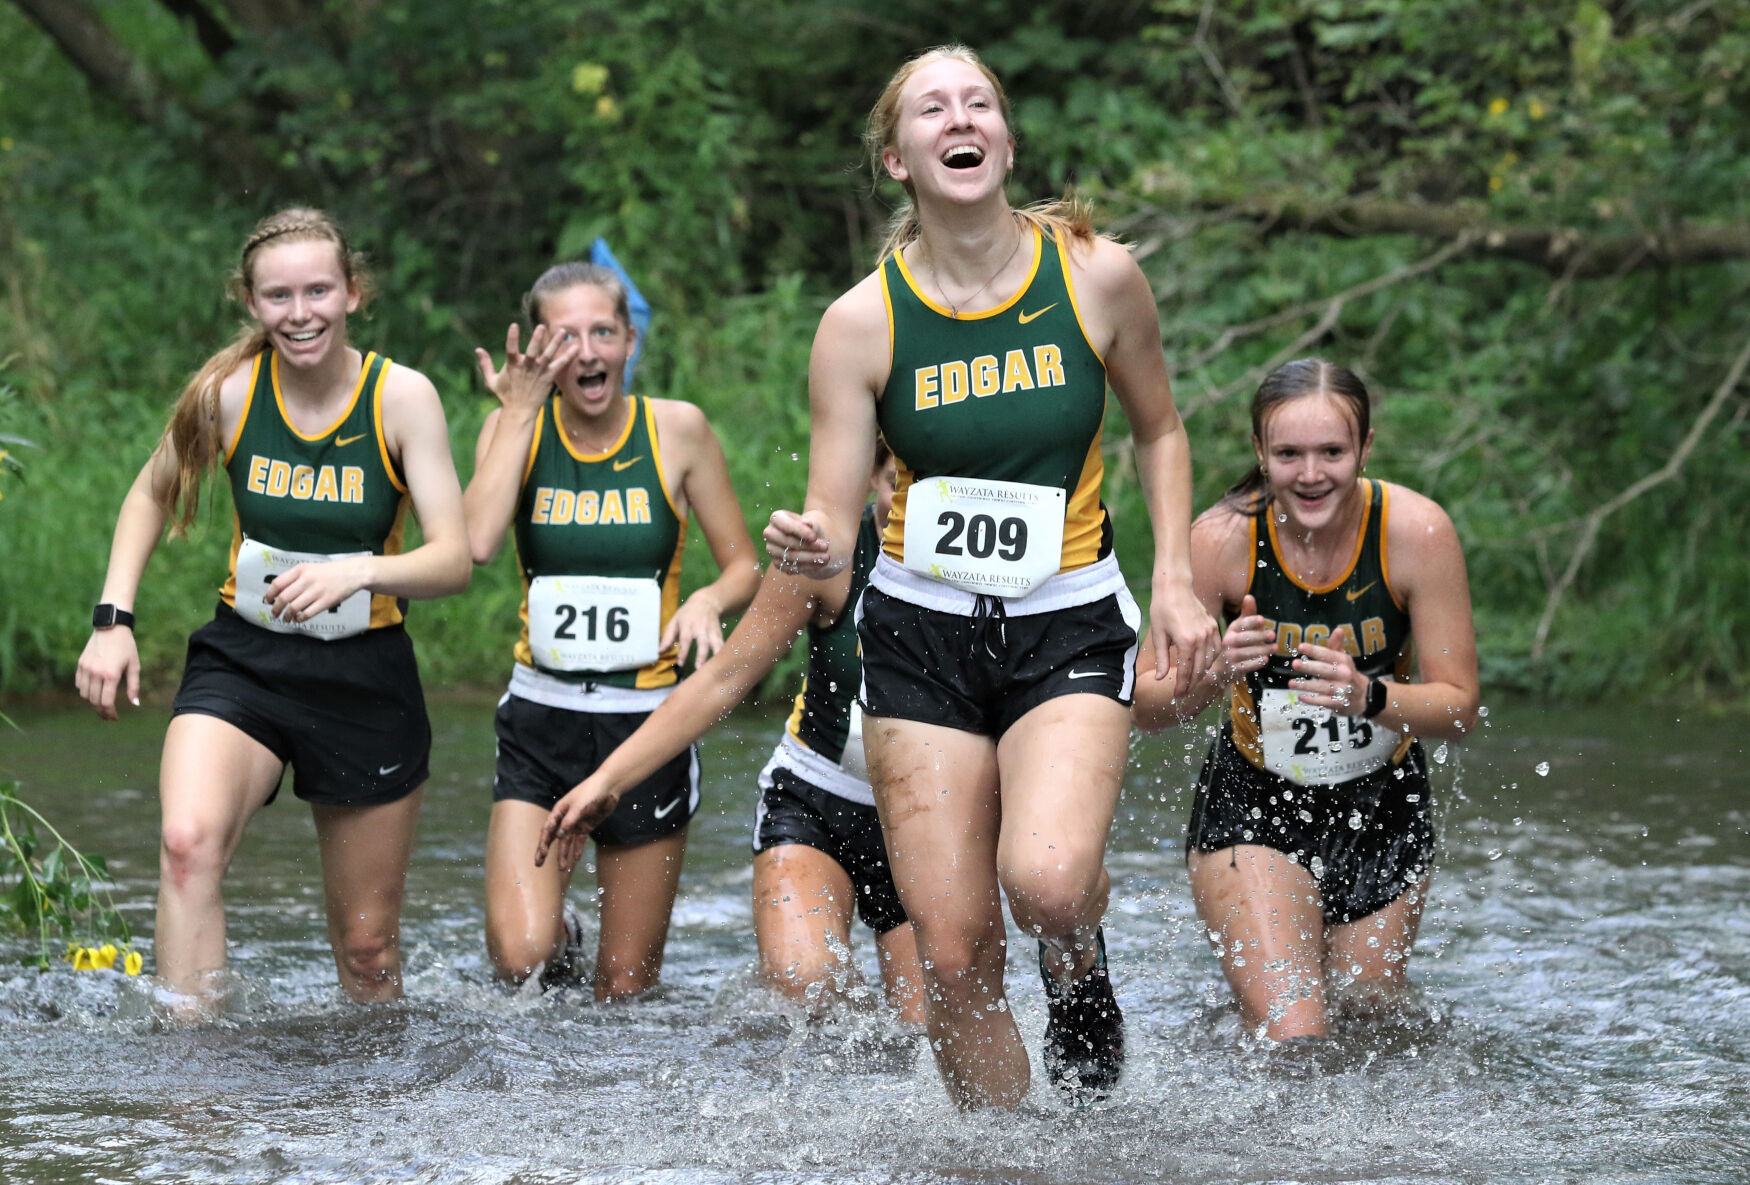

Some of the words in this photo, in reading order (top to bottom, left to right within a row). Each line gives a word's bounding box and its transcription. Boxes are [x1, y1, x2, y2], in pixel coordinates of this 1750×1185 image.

[915, 344, 1066, 411] EDGAR
[248, 455, 364, 503] EDGAR
[949, 485, 994, 498] WAYZATA
[997, 489, 1040, 502] RESULTS
[531, 487, 652, 525] EDGAR
[935, 511, 1028, 562] 209
[942, 569, 987, 582] WAYZATA
[989, 574, 1032, 587] RESULTS
[554, 605, 630, 642] 216
[1292, 717, 1373, 755] 215
